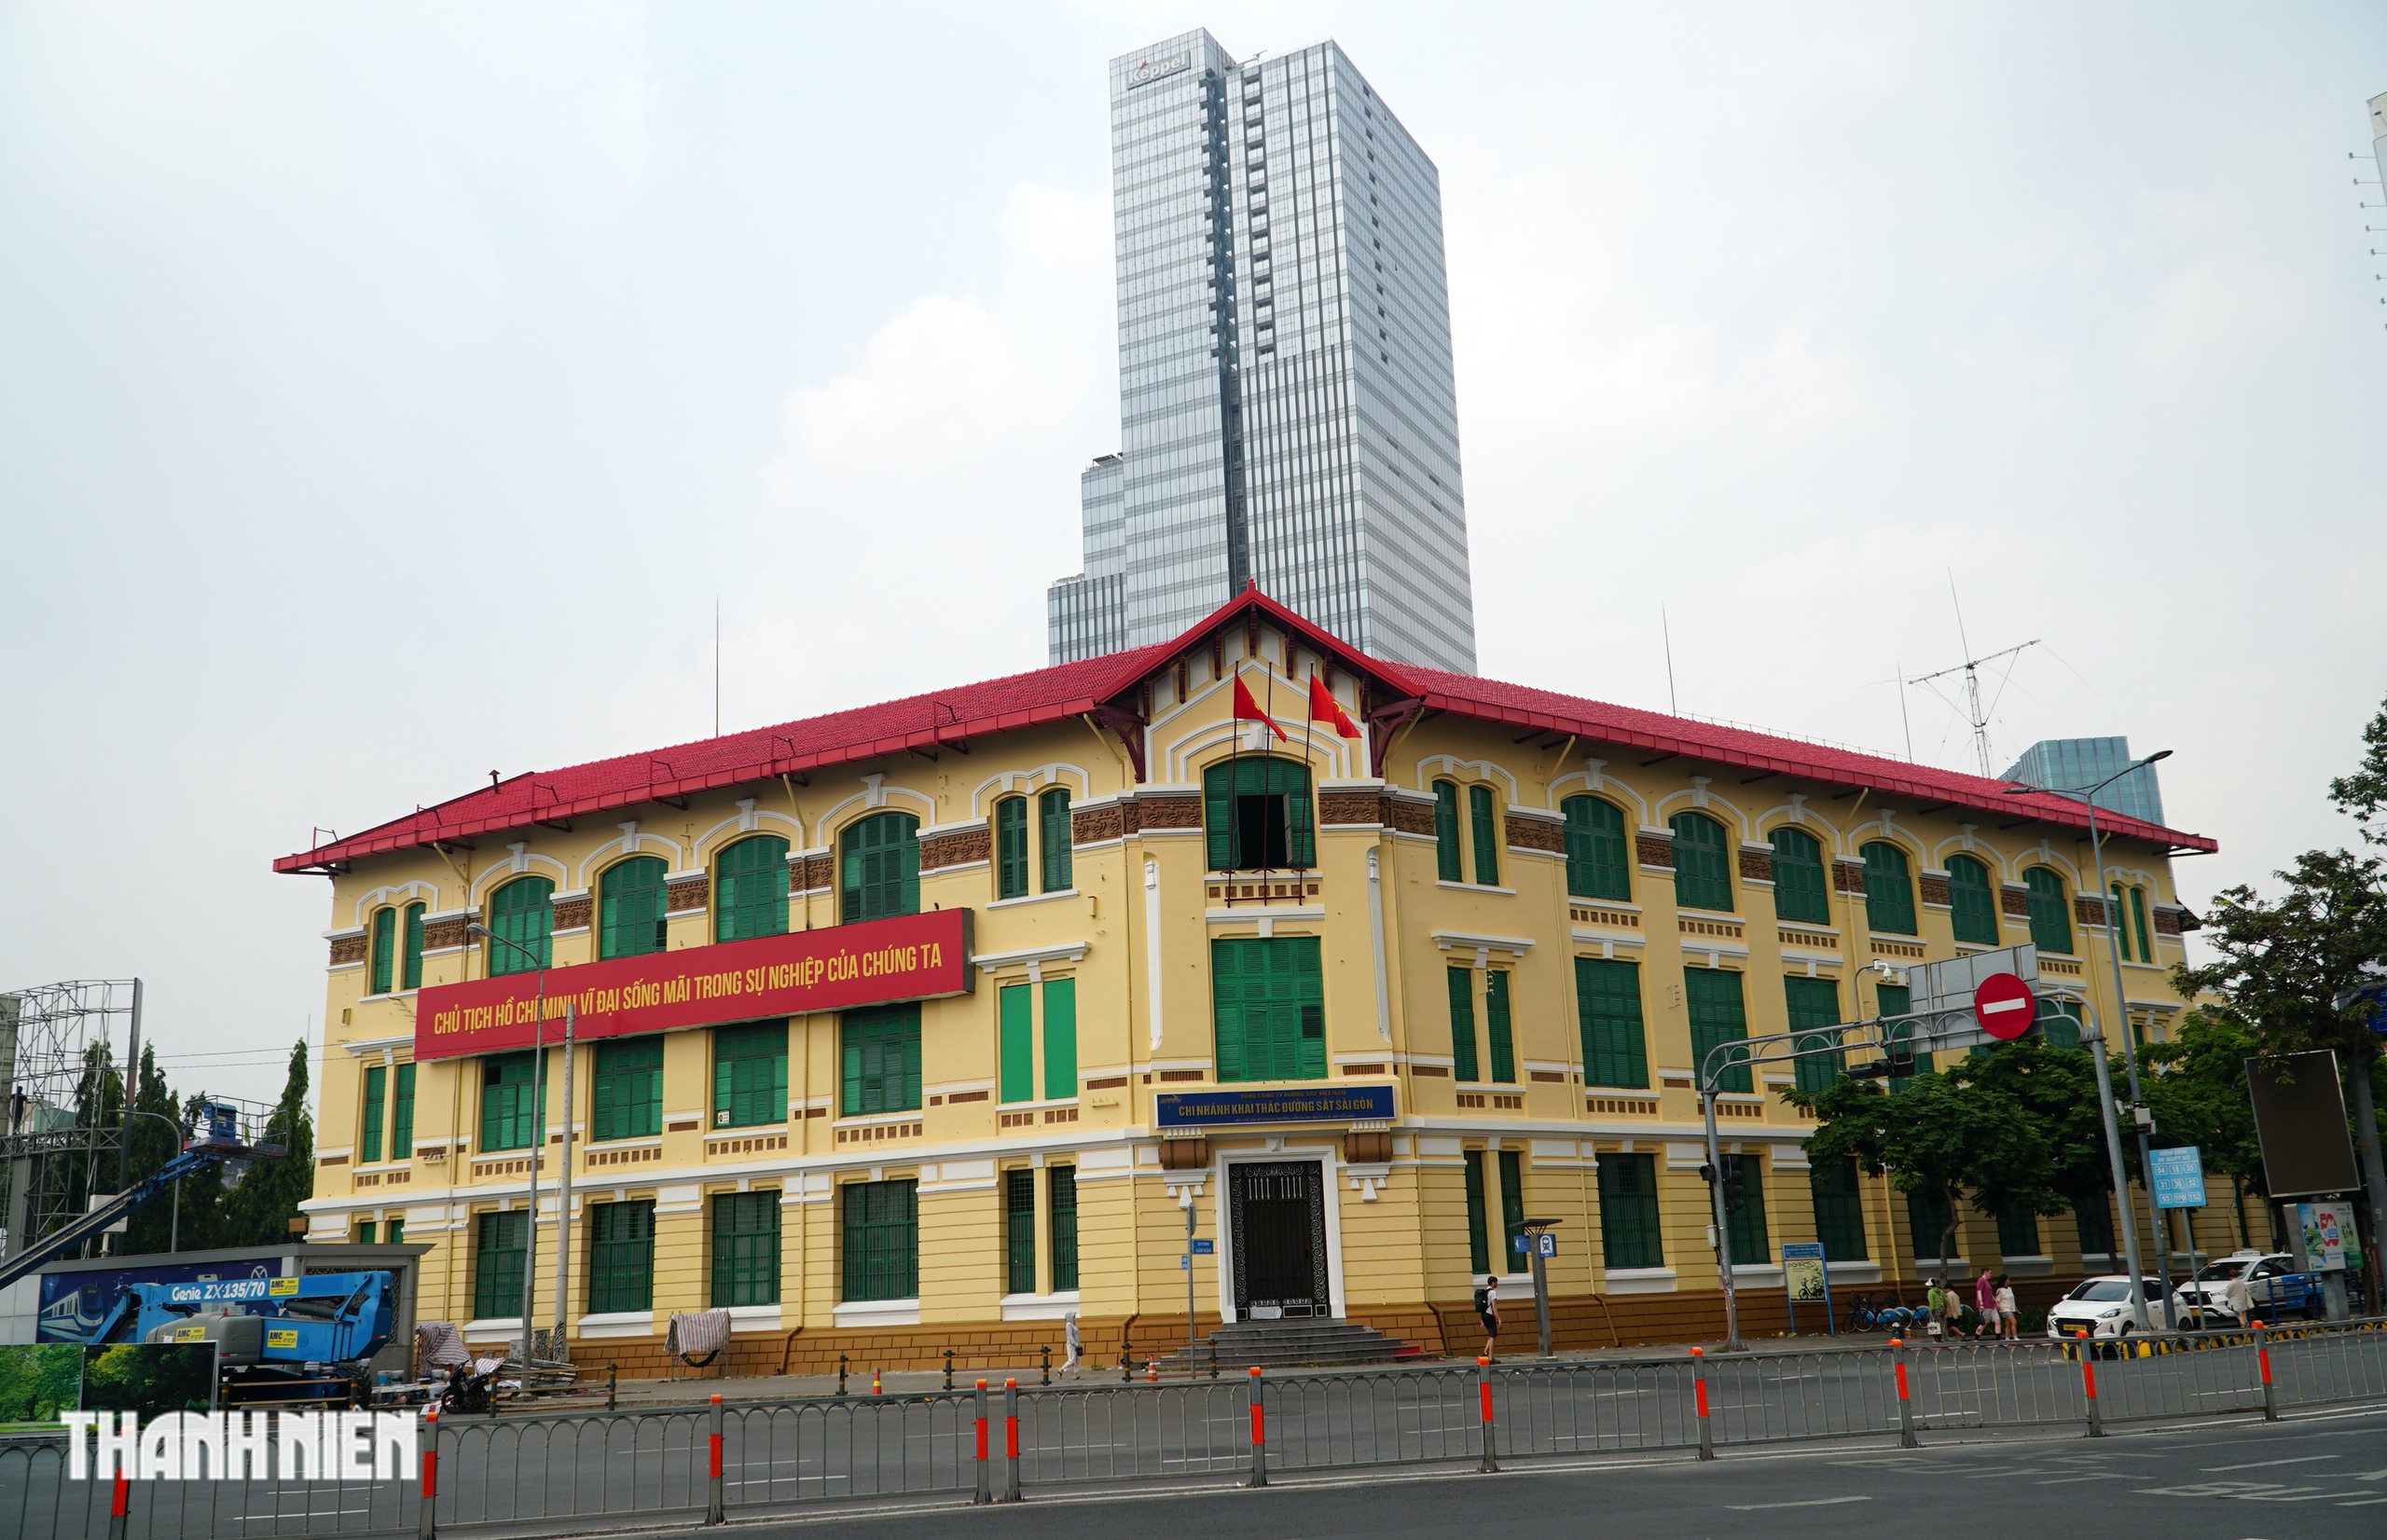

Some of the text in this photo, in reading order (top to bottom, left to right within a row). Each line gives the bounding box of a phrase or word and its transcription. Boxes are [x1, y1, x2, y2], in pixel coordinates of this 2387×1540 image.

[1128, 52, 1186, 84] Keppel
[434, 942, 942, 1035] CHỦ TỊCH HỒ CHÍ MINH VĨ ĐẠI SỐNG MÃI TRONG SỰ NGHIỆP CỦA CHÚNG TA
[1179, 1096, 1373, 1117] CHI NHÁNH KHAI THÁC ĐƯỜNG SẮT SÀI GÒN
[270, 1280, 284, 1288] AMC
[172, 1286, 201, 1301] Genie
[177, 1329, 190, 1338] AMC
[269, 1331, 283, 1340] AMC
